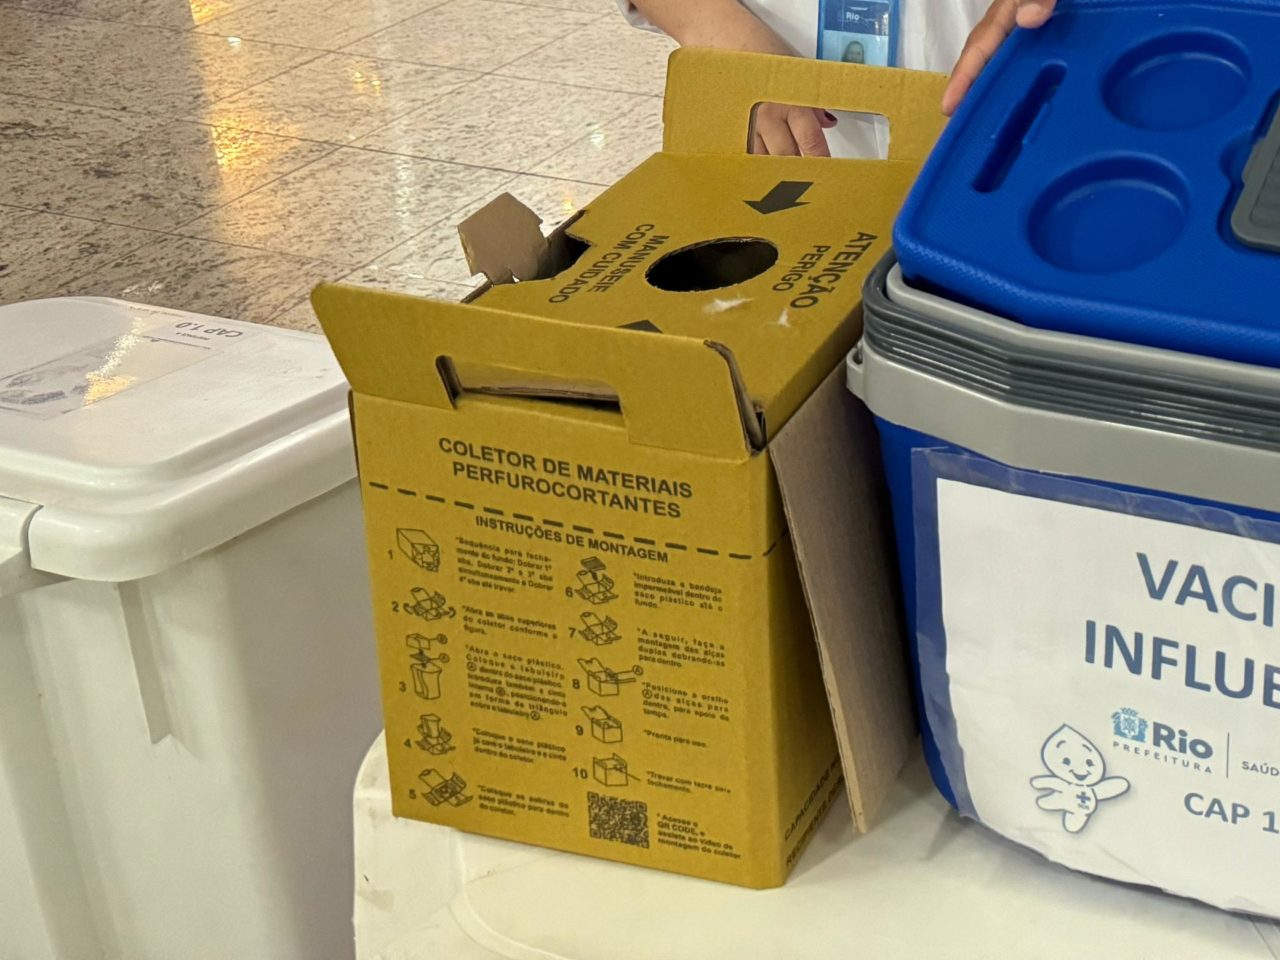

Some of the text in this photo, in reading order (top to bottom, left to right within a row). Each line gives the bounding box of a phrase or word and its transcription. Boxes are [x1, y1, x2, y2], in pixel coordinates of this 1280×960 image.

[548, 223, 655, 304] COM CUIDADO
[588, 235, 670, 293] MANUSEIE
[772, 244, 831, 293] PERIGO
[790, 231, 878, 309] ATENÇÃO
[439, 437, 692, 498] COLETOR DE MATERIAIS
[452, 461, 681, 519] PERFUROCORTANTES
[388, 550, 394, 560] 1
[475, 515, 669, 563] INSTRUÇÕES DE MONTAGEM
[392, 601, 399, 612] 2
[565, 586, 573, 598] 6
[568, 627, 576, 638] 7
[400, 681, 406, 692] 3
[572, 679, 580, 690] 8
[404, 738, 411, 748] 4
[575, 725, 583, 736] 9
[1152, 721, 1214, 759] Rio
[572, 767, 588, 779] 10
[1112, 741, 1213, 774] PREFEITURA
[1184, 792, 1250, 825] CAP
